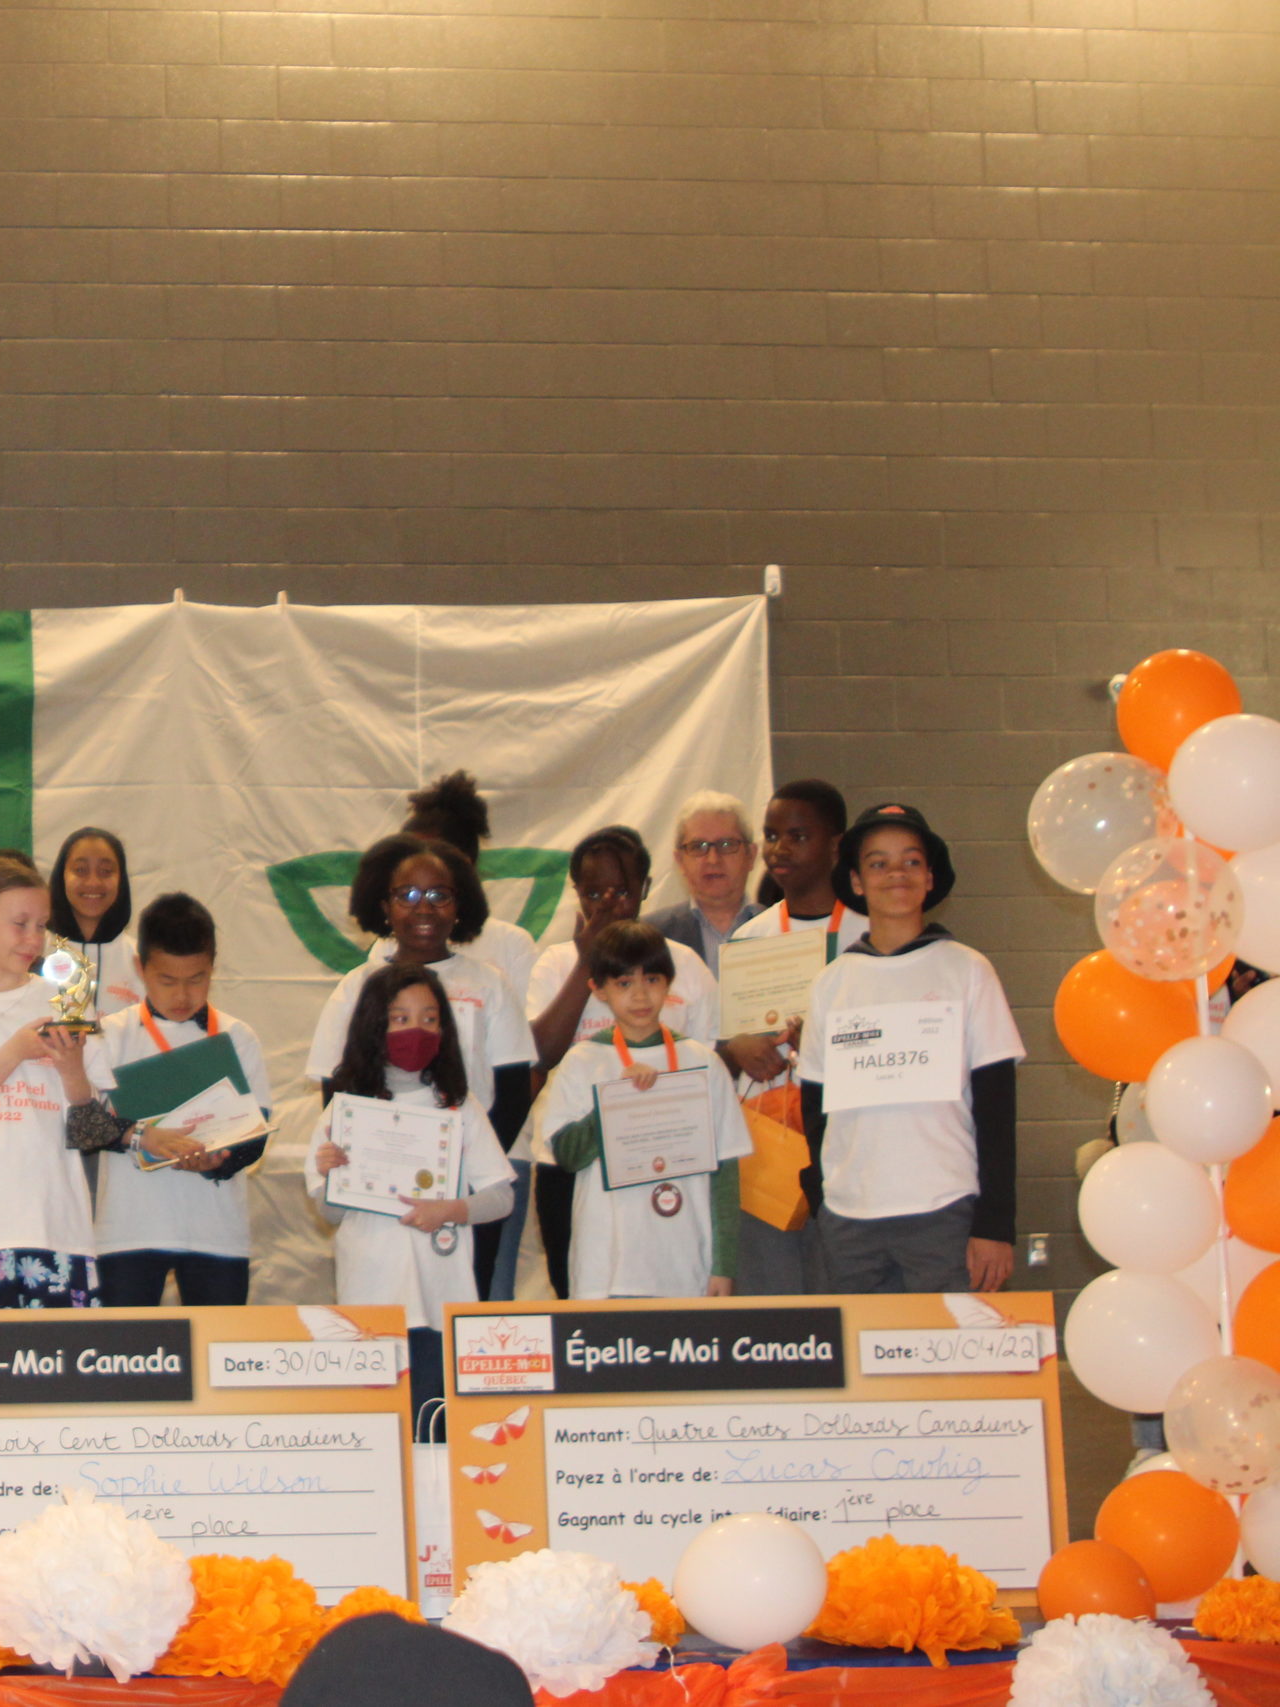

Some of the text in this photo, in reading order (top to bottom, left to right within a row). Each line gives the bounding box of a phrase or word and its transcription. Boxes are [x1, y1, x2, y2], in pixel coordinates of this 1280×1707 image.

[853, 1050, 929, 1070] HAL8376
[76, 1346, 182, 1374] Canada
[224, 1357, 270, 1372] Date:
[566, 1329, 833, 1373] Épelle-Moi Canada
[874, 1344, 919, 1359] Date:
[59, 1426, 120, 1450] Cent
[132, 1425, 239, 1450] Dollards
[244, 1422, 366, 1448] Canadiens
[555, 1428, 630, 1443] Montant:
[638, 1415, 718, 1455] Quatre
[727, 1415, 790, 1440] Cents
[802, 1412, 910, 1437] Dollards
[32, 1481, 59, 1496] de:
[79, 1461, 190, 1503] Sophie
[208, 1462, 332, 1493] Wilson
[556, 1470, 604, 1488] Payez
[612, 1468, 622, 1483] à
[630, 1468, 684, 1483] l'ordre
[693, 1467, 718, 1482] de:
[725, 1450, 852, 1482] Lucas
[191, 1514, 259, 1547] place
[557, 1512, 625, 1531] Gagnant
[634, 1510, 653, 1526] du
[660, 1509, 702, 1530] cycle
[886, 1500, 942, 1528] place
